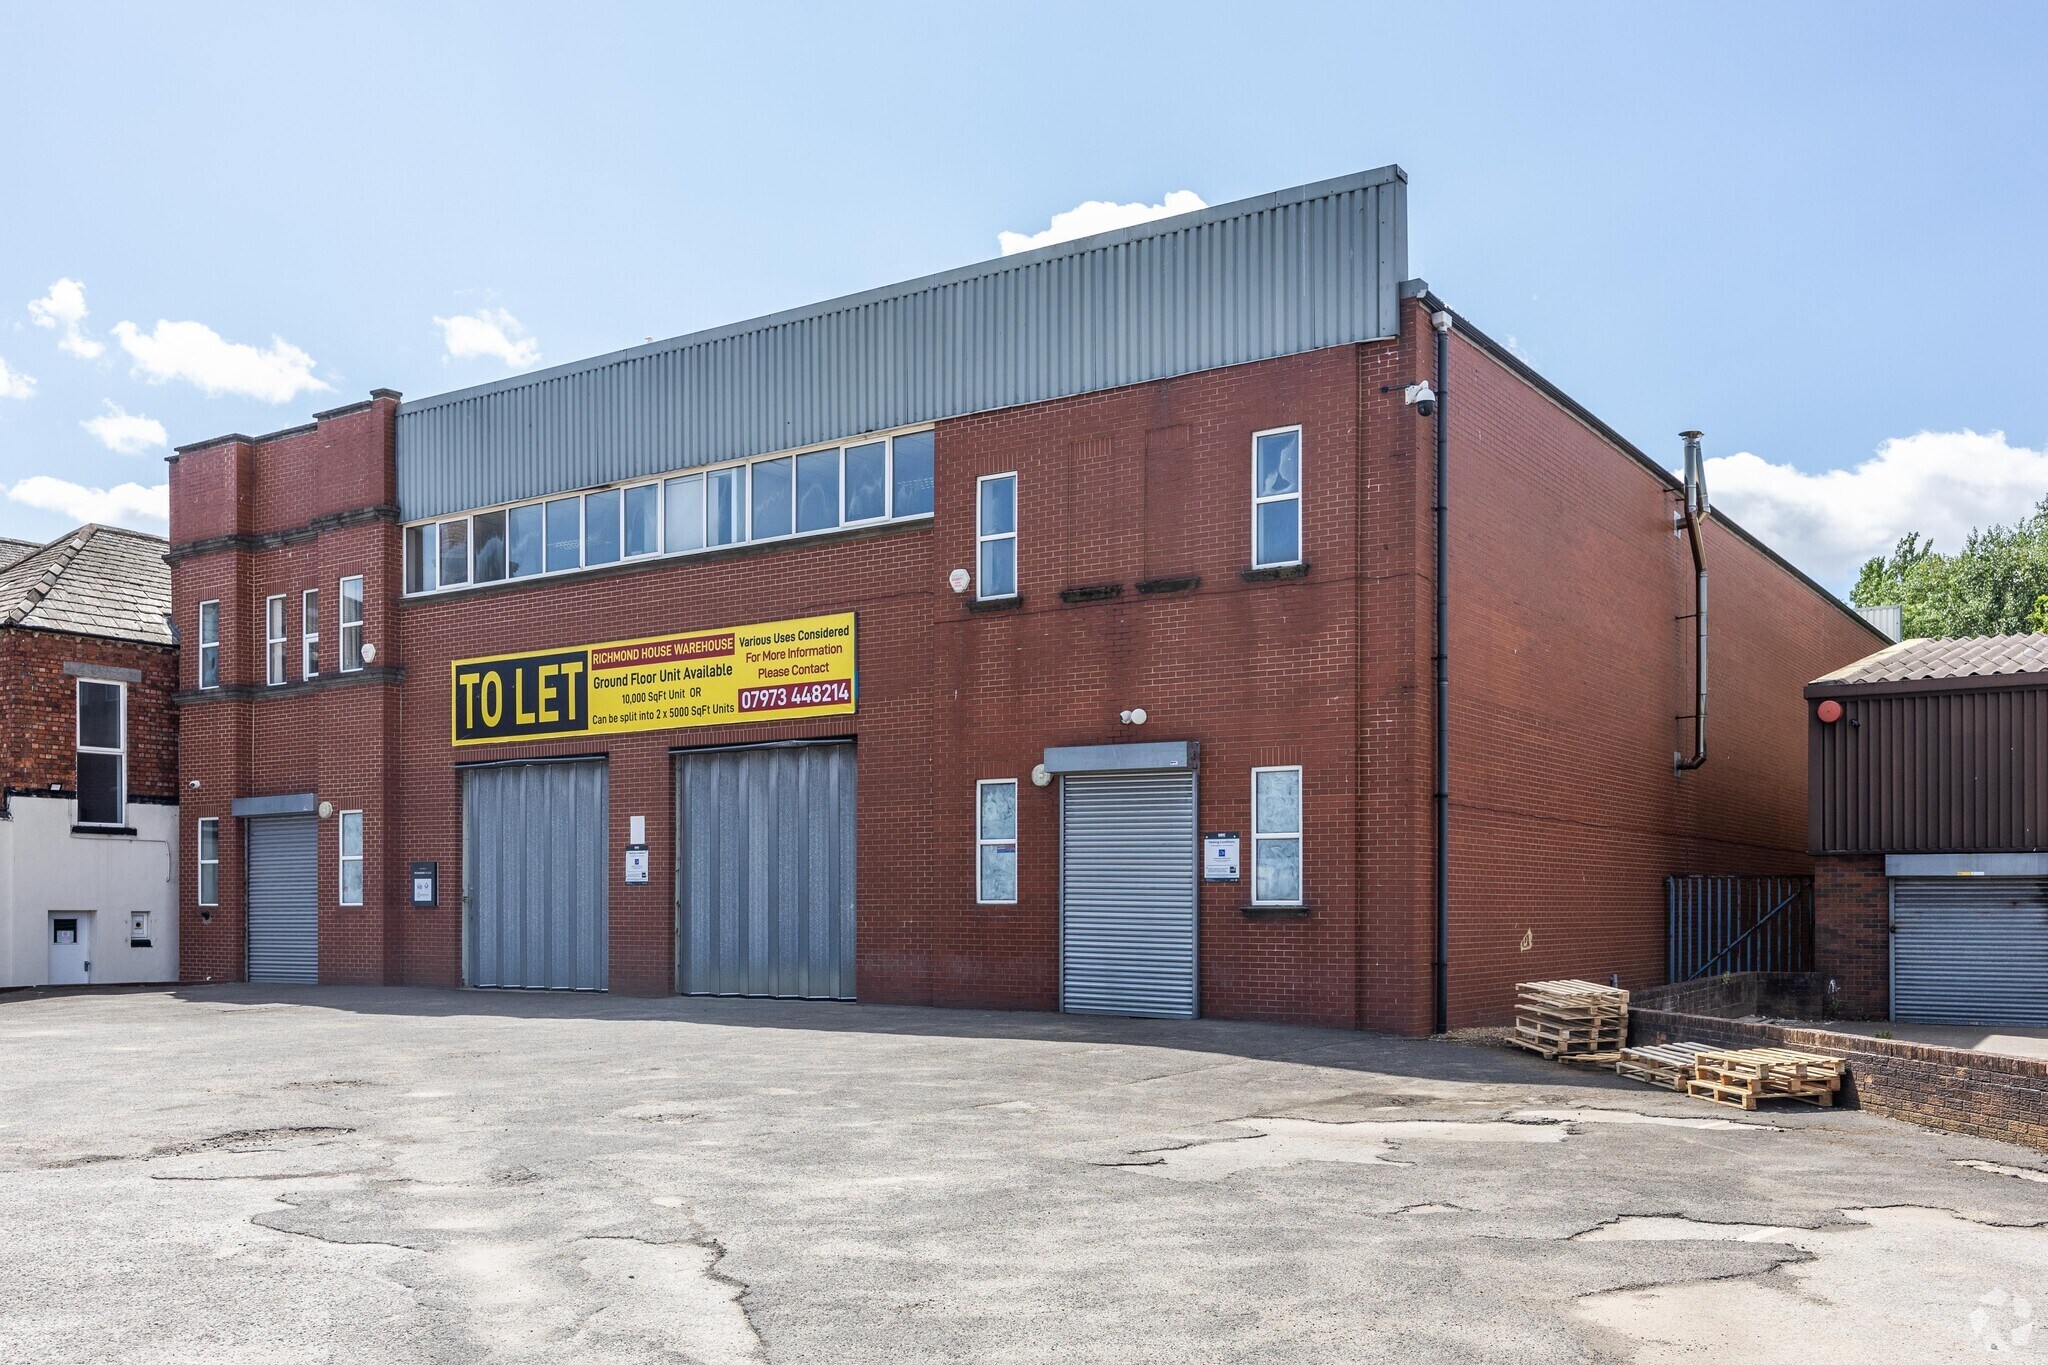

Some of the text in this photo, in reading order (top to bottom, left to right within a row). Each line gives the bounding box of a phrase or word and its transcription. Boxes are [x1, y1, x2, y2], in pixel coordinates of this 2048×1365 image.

[739, 625, 849, 647] Various Uses Considered
[592, 638, 733, 664] RICHMOND HOUSE WAREHOUSE
[746, 644, 843, 663] For More Information
[593, 663, 733, 689] Ground Floor Unit Available
[758, 662, 829, 679] Please Contact
[460, 661, 583, 729] TO LET
[622, 687, 702, 705] 10,000 SqFt Unit OR
[741, 682, 849, 709] 07973 448214
[592, 714, 607, 725] Can
[608, 713, 618, 723] be
[620, 711, 637, 726] split
[638, 710, 654, 721] into
[656, 709, 661, 719] 2
[669, 706, 689, 718] 5000
[691, 705, 710, 717] SqFt
[712, 703, 735, 714] Units
